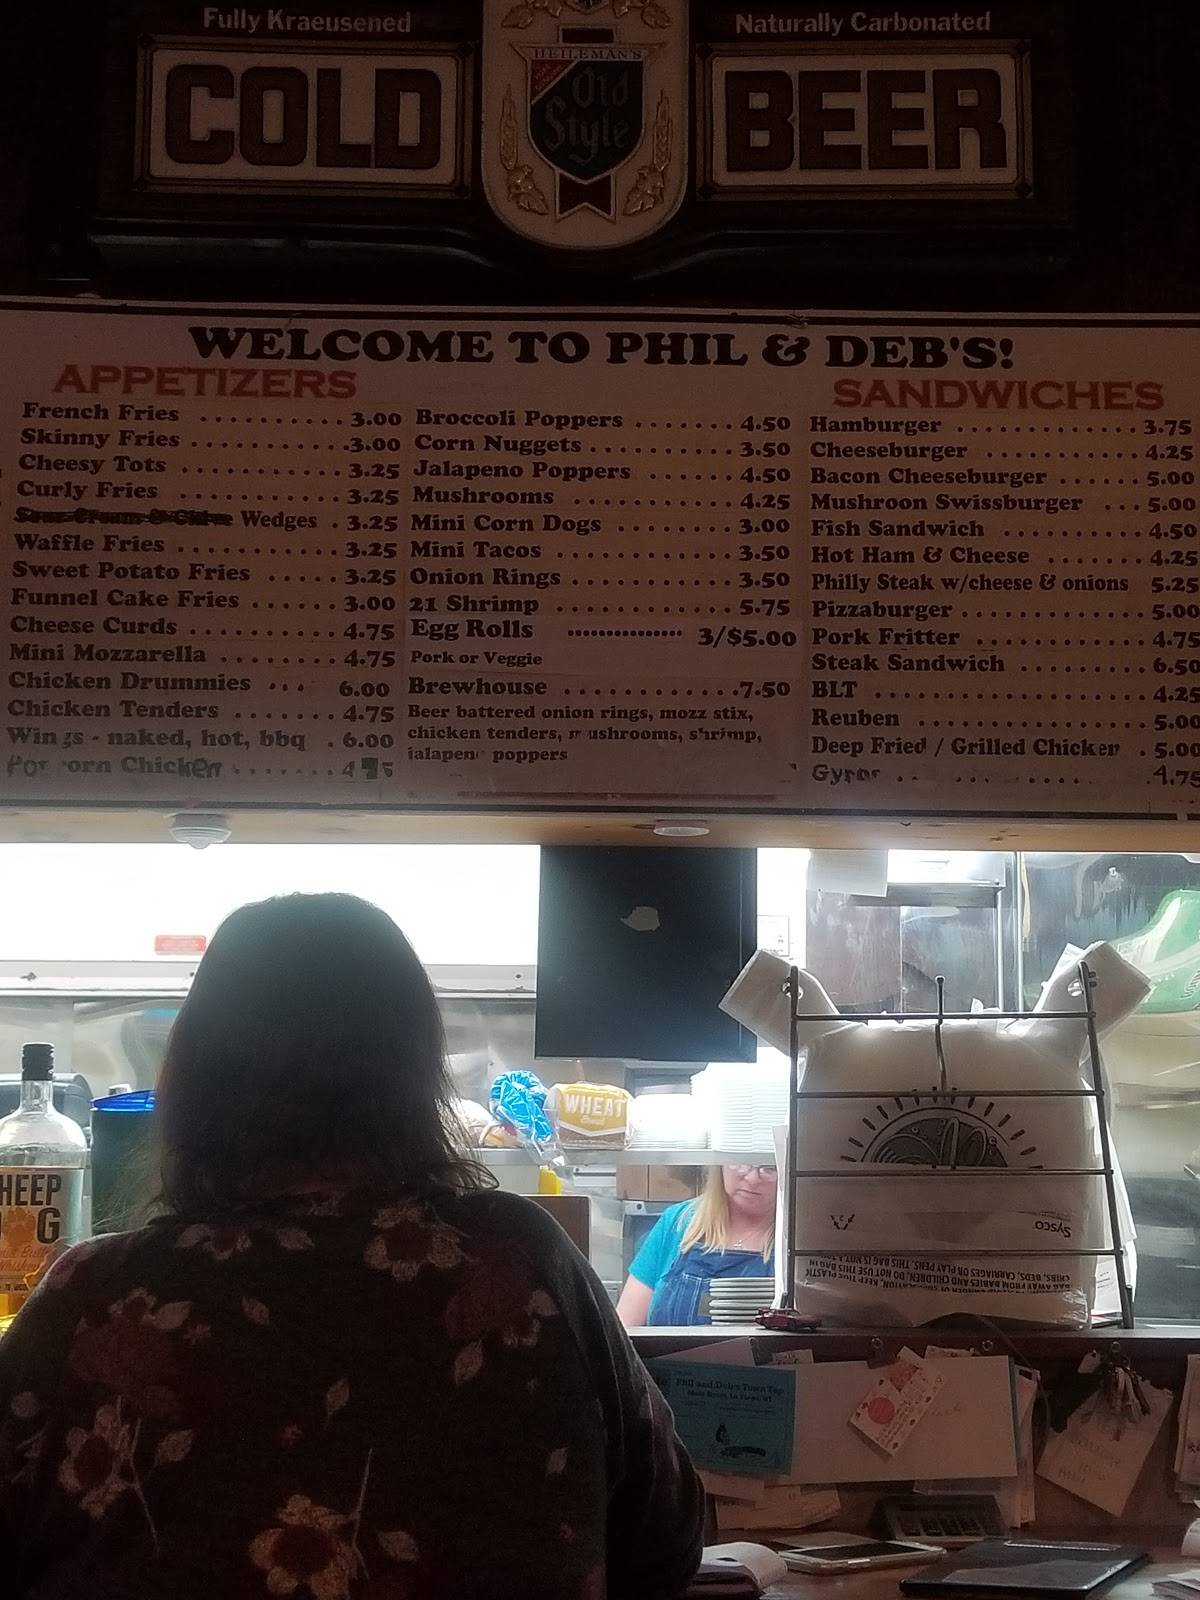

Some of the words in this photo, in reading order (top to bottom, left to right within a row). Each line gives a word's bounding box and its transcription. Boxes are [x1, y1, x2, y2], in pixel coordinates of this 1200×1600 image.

[203, 6, 258, 35] Fully
[265, 9, 412, 33] Kraeusened
[735, 10, 843, 36] Naturally
[850, 10, 992, 33] Carbonated
[572, 66, 630, 110] Old
[165, 64, 441, 169] COLD
[724, 69, 1011, 171] BEER
[543, 97, 632, 165] Style
[188, 326, 494, 364] WELCOME
[511, 330, 590, 363] TO
[606, 333, 747, 365] PHIL
[761, 333, 809, 367] &
[825, 336, 1014, 370] DEB'S!
[52, 364, 356, 399] APPETIZERS
[833, 378, 1164, 411] SANDWICHES
[22, 402, 109, 420] French
[118, 404, 179, 421] Fries
[351, 412, 402, 427] 3.00
[416, 409, 516, 426] Broccoli
[524, 410, 623, 431] Poppers
[740, 416, 791, 432] 4.50
[810, 416, 942, 436] Hamburger
[1144, 419, 1192, 436] 3.75
[20, 428, 110, 449] Skinny
[118, 430, 180, 447] Fries
[349, 437, 400, 453] 3.00
[414, 434, 475, 451] Corn
[483, 435, 581, 456] Nuggets
[740, 442, 791, 458] 3.50
[810, 441, 968, 462] Cheeseburger
[1145, 444, 1194, 461] 4.25
[19, 454, 106, 475] Cheesy
[113, 456, 167, 472] Tots
[348, 463, 400, 480] 3.25
[413, 460, 524, 481] Jalapeno
[532, 462, 631, 482] Poppers
[740, 466, 791, 484] 4.50
[810, 467, 880, 484] Bacon
[888, 468, 1047, 488] Cheeseburger
[1147, 471, 1194, 487] 5.00
[17, 480, 88, 501] Curly
[95, 481, 158, 499] Fries
[347, 489, 399, 506] 3.25
[412, 486, 554, 504] Mushrooms
[740, 493, 790, 510] 4.25
[935, 493, 1083, 514] Swissburger
[1148, 497, 1196, 513] 5.00
[240, 510, 317, 532] Wedges
[347, 515, 398, 532] 3.25
[411, 514, 465, 531] Mini
[474, 514, 534, 531] Corn
[542, 514, 601, 536] Dogs
[738, 519, 790, 534] 3.00
[811, 519, 860, 536] Fish
[868, 520, 984, 537] Sandwich
[1149, 523, 1197, 540] 4.50
[14, 533, 94, 551] Waffle
[102, 534, 165, 552] Fries
[345, 542, 397, 559] 3.25
[410, 541, 464, 558] Mini
[473, 541, 541, 558] Tacos
[739, 545, 790, 562] 3.50
[811, 546, 854, 563] Hot
[862, 546, 915, 563] Ham
[923, 546, 943, 563] &
[950, 546, 1029, 564] Cheese
[1150, 550, 1198, 567] 4.25
[12, 560, 90, 578] Sweet
[97, 562, 180, 580] Potato
[188, 563, 250, 581] Fries
[345, 569, 396, 586] 3.25
[410, 567, 484, 585] Onion
[492, 568, 561, 589] Rings
[739, 572, 790, 589] 3.50
[811, 573, 871, 594] Philly
[877, 573, 935, 590] Steak
[940, 574, 1033, 593] w/cheese
[1039, 573, 1056, 590] &
[1062, 578, 1128, 591] onions
[1151, 577, 1199, 594] 5.25
[10, 588, 98, 606] Funnel
[107, 589, 169, 607] Cake
[177, 590, 239, 608] Fries
[344, 596, 395, 612] 3.00
[409, 597, 438, 612] 21
[446, 595, 539, 616] Shrimp
[740, 599, 790, 616] 5.75
[812, 600, 953, 622] Pizzaburger
[1152, 604, 1200, 621] 5.00
[10, 615, 94, 634] Cheese
[103, 616, 177, 635] Curds
[343, 622, 395, 641] 4.75
[410, 619, 459, 641] Egg
[466, 619, 533, 638] Rolls
[698, 625, 796, 648] 3/$5.00
[812, 628, 871, 645] Pork
[878, 628, 960, 645] Fritter
[1152, 630, 1200, 649] 4.75
[9, 643, 64, 661] Mini
[72, 643, 206, 662] Mozzarella
[344, 649, 395, 668] 4.75
[411, 650, 455, 663] Pork
[459, 654, 479, 664] or
[483, 651, 542, 668] Veggie
[811, 653, 880, 671] Steak
[888, 653, 1005, 672] Sandwich
[1153, 657, 1200, 676] 6.50
[8, 671, 111, 690] Chicken
[120, 672, 251, 691] Drummies
[339, 680, 390, 697] 6.00
[408, 676, 547, 695] Brewhouse
[740, 681, 790, 699] 7.50
[811, 681, 858, 698] BLT
[1153, 686, 1200, 704] 4.25
[7, 699, 110, 717] Chicken
[119, 700, 219, 718] Tenders
[343, 705, 394, 723] 4.75
[408, 704, 450, 718] Beer
[456, 705, 536, 718] battered
[541, 709, 594, 719] onion
[600, 706, 653, 722] rings,
[660, 709, 707, 719] mozz
[713, 706, 753, 722] stix,
[812, 708, 900, 726] Reuben
[1154, 714, 1200, 731] 5.00
[107, 728, 191, 749] naked,
[201, 729, 250, 750] hot,
[259, 729, 306, 752] bbq
[343, 732, 394, 748] 6.00
[408, 725, 481, 739] chicken
[487, 726, 562, 743] tenders,
[492, 750, 568, 764] poppers
[812, 736, 864, 758] Deep
[871, 737, 927, 754] Fried
[934, 737, 944, 758] /
[951, 737, 1026, 755] Grilled
[1154, 742, 1200, 759] 5.00
[565, 1093, 627, 1119] WHEAT
[0, 1174, 62, 1206] HEEP
[1034, 1216, 1072, 1238] Sysco
